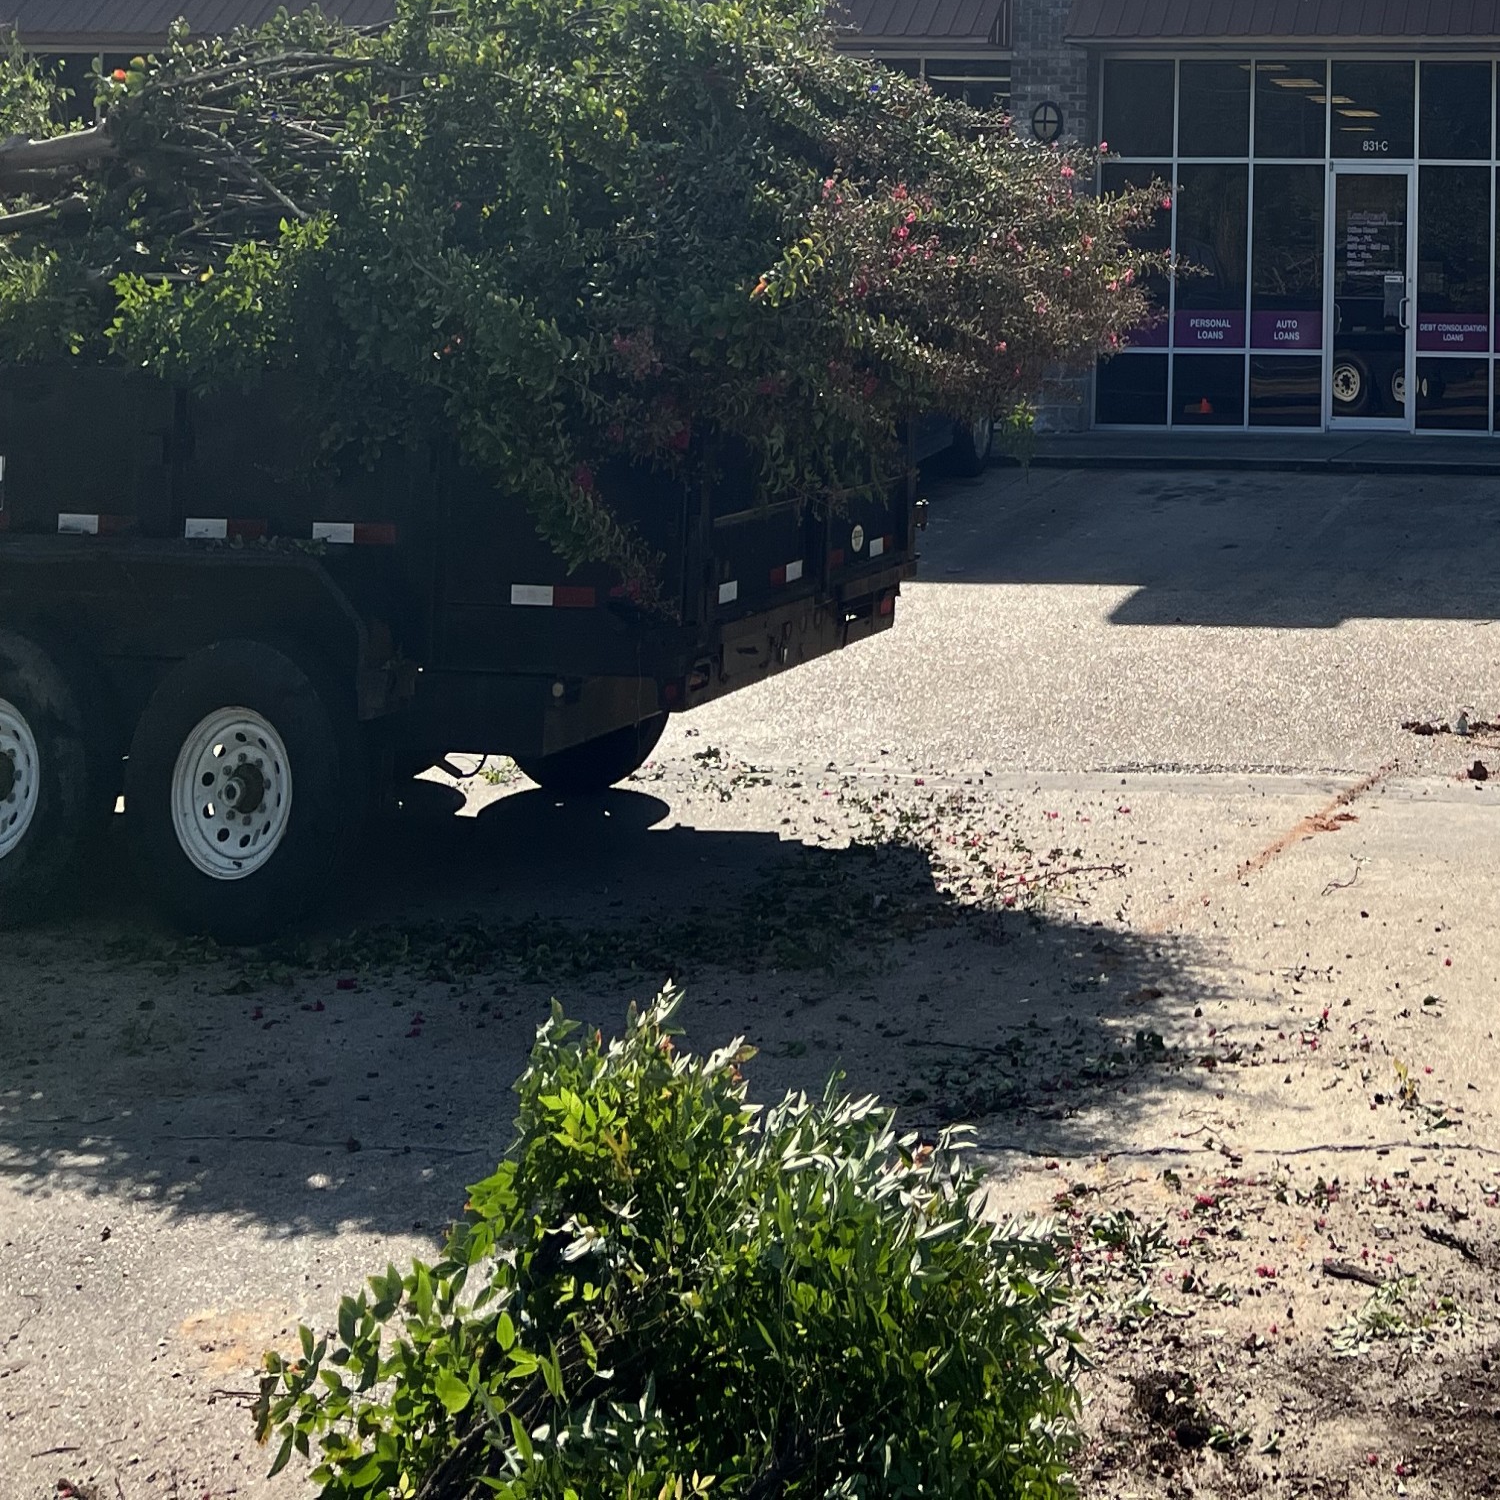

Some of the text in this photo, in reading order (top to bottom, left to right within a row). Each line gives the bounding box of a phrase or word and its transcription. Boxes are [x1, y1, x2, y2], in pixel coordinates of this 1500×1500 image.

[1362, 140, 1389, 152] 831-C
[1190, 319, 1232, 328] PERSONAL
[1276, 320, 1298, 329] AUTO
[1419, 323, 1488, 332] DEBT CONSOLIDATION
[1197, 330, 1224, 340] LOANS
[1273, 331, 1300, 341] LOANS
[1442, 333, 1465, 342] LOANS
